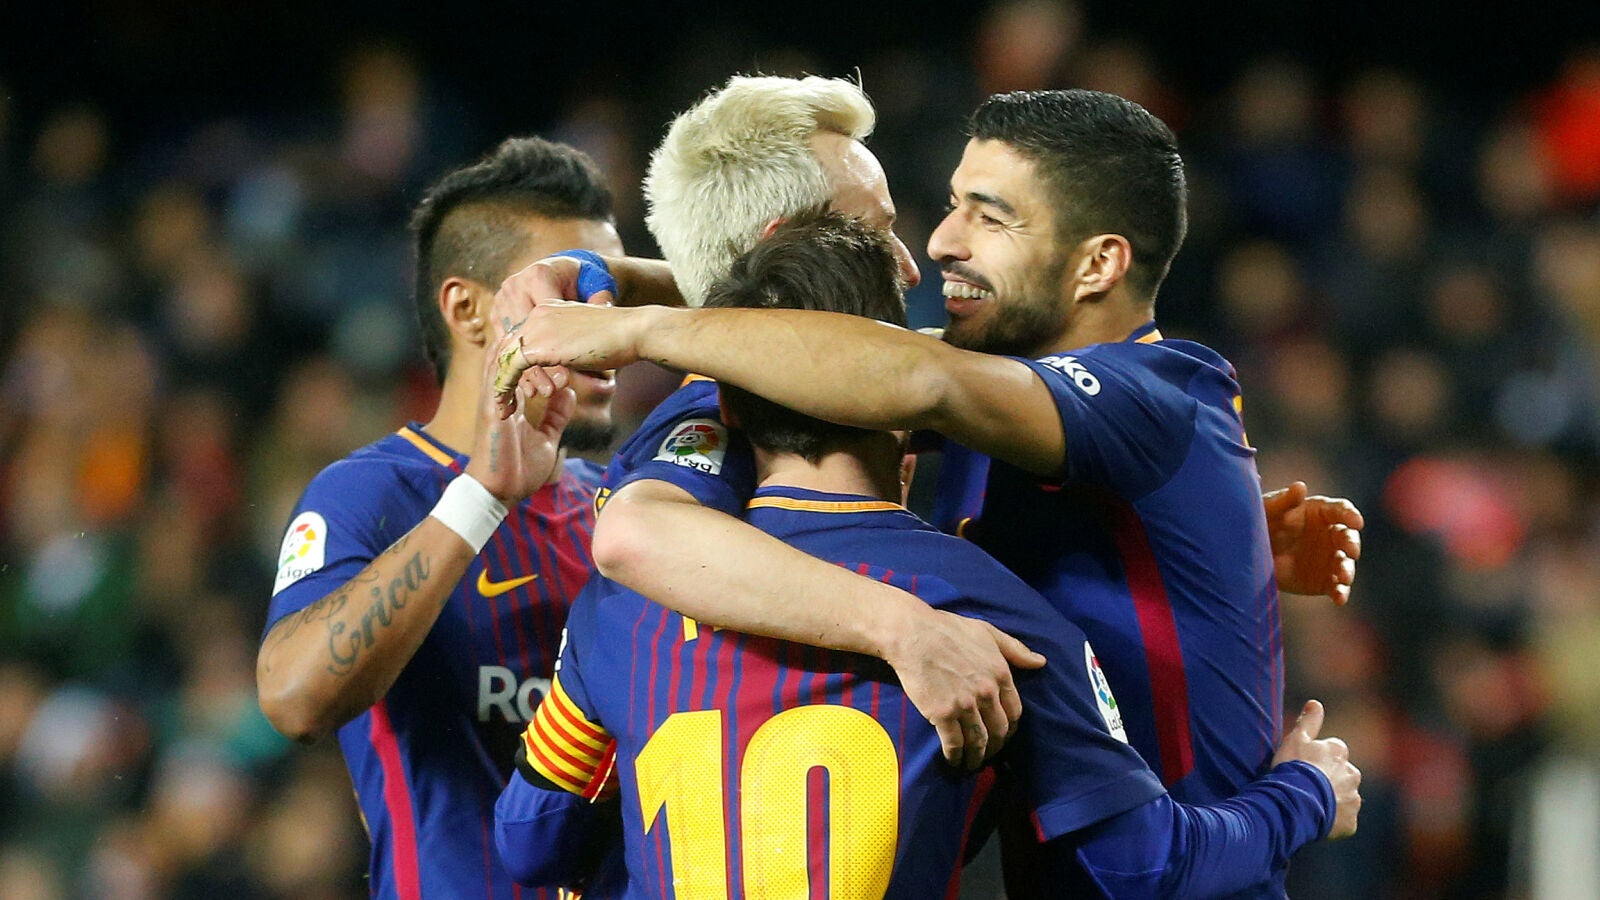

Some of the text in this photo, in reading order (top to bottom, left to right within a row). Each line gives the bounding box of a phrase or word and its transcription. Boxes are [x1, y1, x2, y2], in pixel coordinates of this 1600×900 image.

[1035, 355, 1101, 397] eko
[279, 566, 315, 579] Liga
[326, 551, 430, 677] Erica
[634, 703, 899, 900] 10
